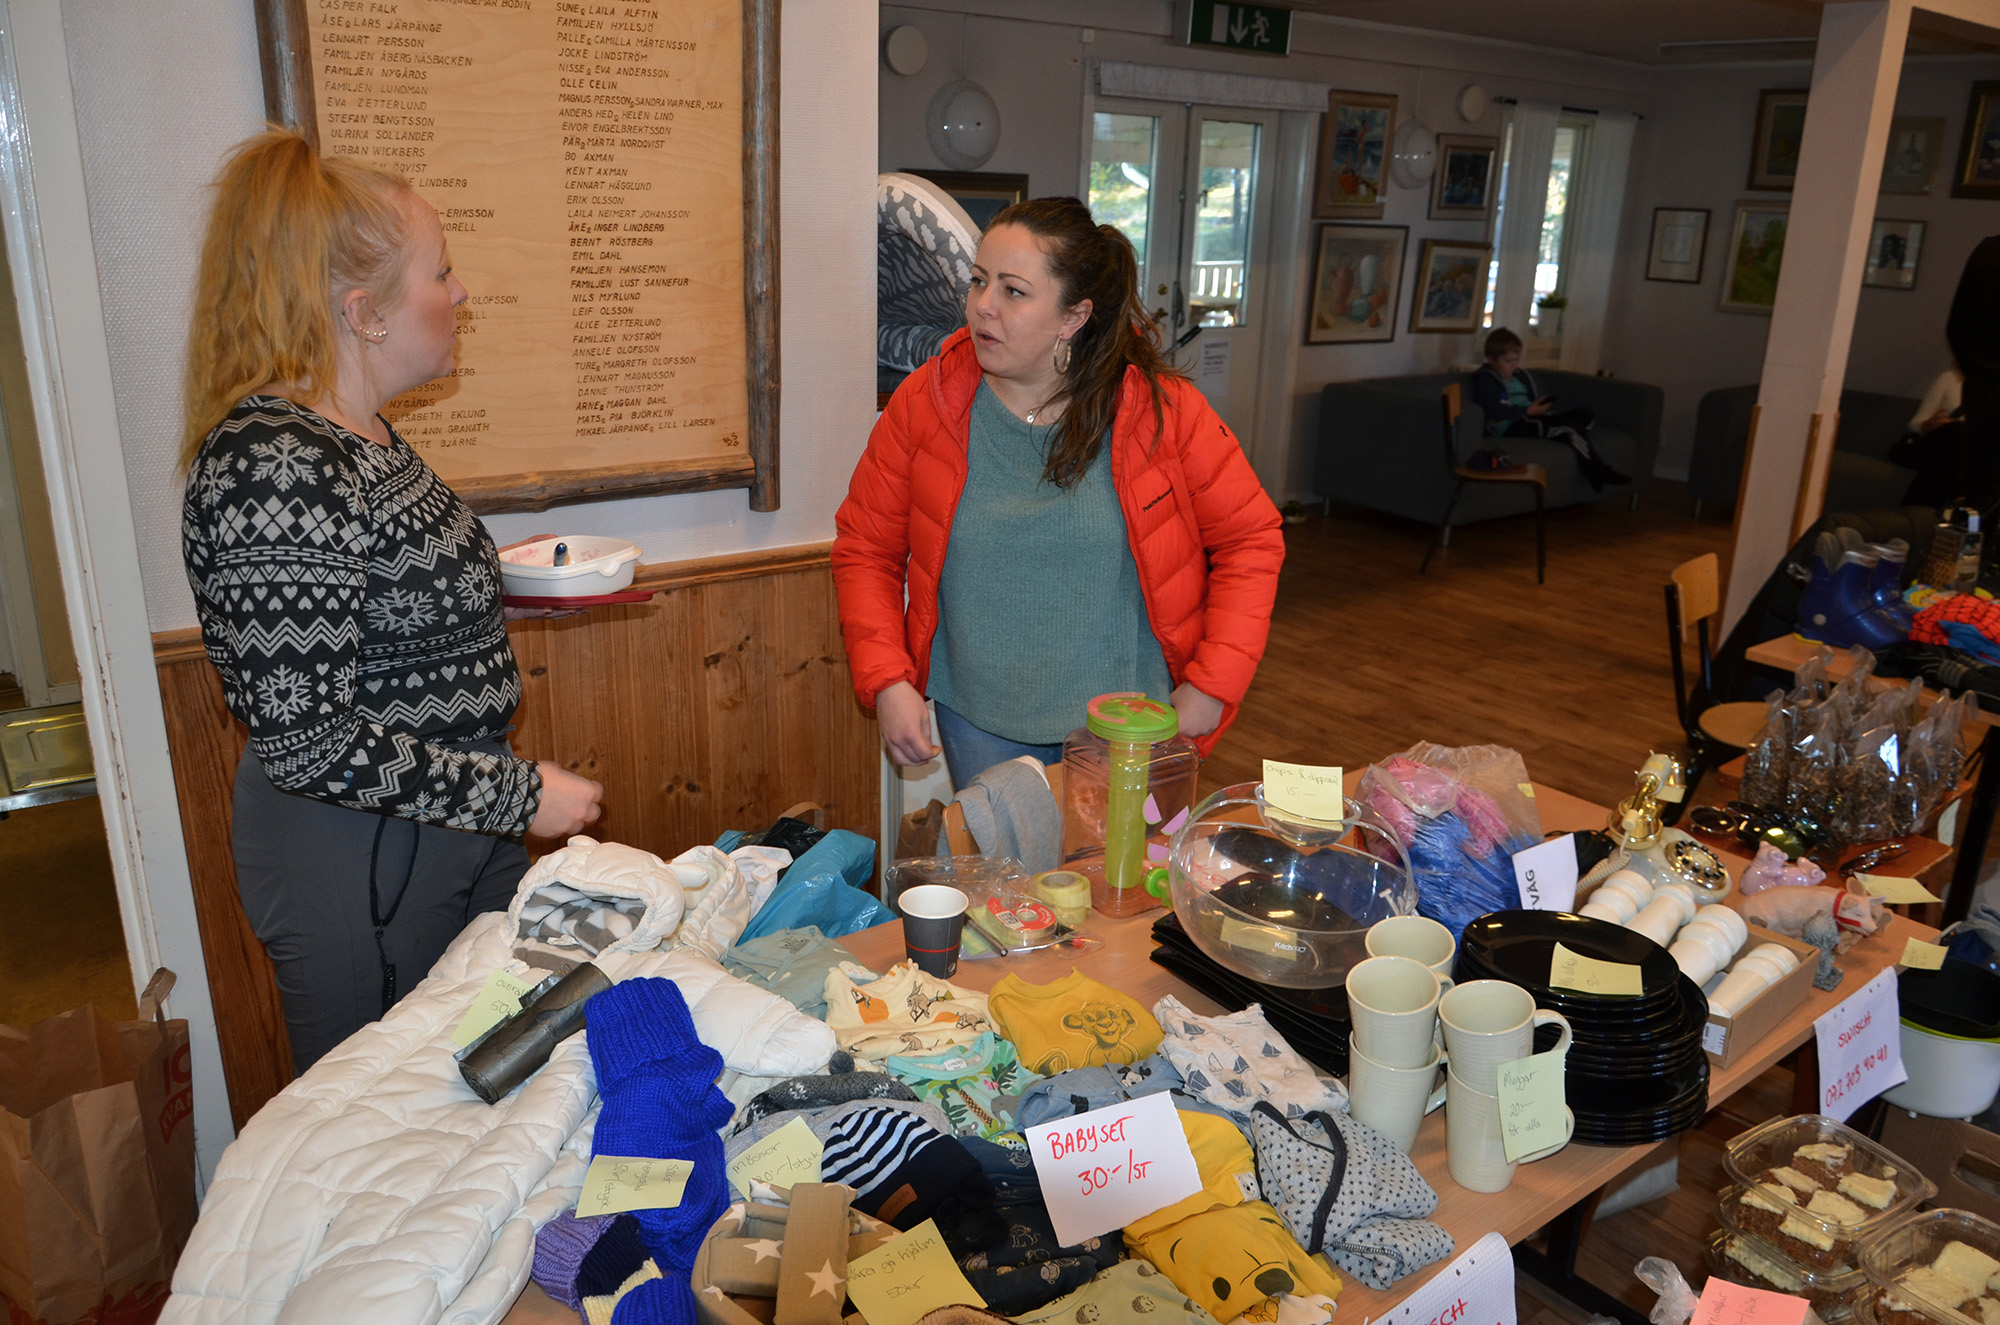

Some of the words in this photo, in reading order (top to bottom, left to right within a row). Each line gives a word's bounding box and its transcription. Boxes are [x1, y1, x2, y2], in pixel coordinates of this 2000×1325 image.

[320, 0, 363, 11] CASPER
[371, 3, 398, 14] FALK
[557, 2, 579, 13] SUNE
[589, 6, 615, 15] LAILA
[354, 18, 380, 28] LARS
[557, 15, 603, 29] FAMILJEN
[323, 33, 370, 44] LENNART
[377, 37, 424, 47] PERSSON
[557, 32, 588, 44] PALLE
[594, 35, 631, 46] CAMILLA
[324, 49, 374, 60] FAMILJEN
[380, 50, 412, 63] ÅBERG
[415, 53, 472, 66] NÄSBACKEN
[559, 48, 588, 58] JOCKE
[595, 52, 647, 62] LINDSTRÖM
[325, 65, 373, 76] FAMILJEN
[559, 64, 587, 73] NISSE
[595, 65, 610, 74] EVA
[617, 68, 669, 78] ANDERSSON
[325, 81, 372, 92] FAMILJEN
[381, 85, 428, 94] LUNDMAN
[560, 78, 584, 88] OLLE
[589, 80, 617, 89] CELIN
[327, 97, 346, 107] EVA
[358, 98, 427, 110] ZETTERLUND
[559, 94, 591, 103] MAGNUS
[594, 95, 632, 107] PERSSON
[633, 97, 665, 106] SANDRA
[706, 101, 722, 109] MAX
[329, 113, 368, 123] STEFAN
[373, 115, 434, 126] BENGTSSON
[559, 108, 592, 117] ANDERS
[596, 110, 615, 118] HED
[622, 111, 650, 120] HELEN
[654, 112, 674, 120] LIND
[331, 129, 368, 139] ULRIKA
[376, 130, 434, 141] SOLLANDER
[563, 135, 583, 148] PÄR
[587, 136, 614, 146] MÄRTA
[621, 139, 665, 148] NORDQVIST
[334, 145, 369, 155] URBAN
[565, 152, 576, 161] BO
[566, 167, 593, 175] KENT
[596, 168, 627, 176] AXMAN
[420, 178, 467, 187] LINDBERG
[565, 181, 605, 189] LENNART
[609, 180, 651, 190] HÄGGLUND
[567, 195, 588, 204] ERIK
[592, 196, 624, 204] OLSSON
[568, 210, 592, 218] LAILA
[640, 210, 689, 218] JOHANSSON
[569, 222, 588, 232] ÅKE
[594, 223, 618, 231] INGER
[624, 223, 664, 232] LINDBERG
[570, 238, 601, 246] BERNT
[573, 252, 594, 260] EMIL
[600, 252, 620, 260] DAHL
[571, 266, 612, 274] FAMILJEN
[571, 280, 612, 288] FAMILJEN
[472, 296, 518, 304] OLOFSSON
[572, 294, 594, 302] NILS
[599, 292, 640, 301] MYRLUND
[573, 307, 593, 316] LEIF
[600, 307, 633, 315] OLSSON
[574, 321, 599, 329] ALICE
[607, 319, 661, 328] ZETTERLUND
[573, 334, 616, 343] FAMILJEN
[573, 347, 611, 357] ANNELIE
[617, 345, 659, 354] OLOFSSON
[575, 362, 597, 371] TURE
[603, 359, 647, 368] MARGRETH
[653, 357, 696, 365] OLOFSSON
[577, 374, 619, 383] LENNART
[624, 371, 675, 380] MAGNUSSON
[578, 387, 607, 396] DANNE
[576, 401, 601, 410] ARNE
[606, 398, 641, 408] MAGGAN
[647, 397, 665, 405] DAHL
[388, 412, 442, 423] ELISABETH
[451, 409, 485, 419] EKLUND
[577, 415, 603, 424] MATS
[448, 423, 489, 433] GRANATH
[576, 427, 606, 436] MIKAEL
[659, 421, 677, 429] LILL
[683, 418, 715, 427] LARSEN
[1838, 1011, 1873, 1048] SWISCH
[1047, 1115, 1135, 1160] BABYSET
